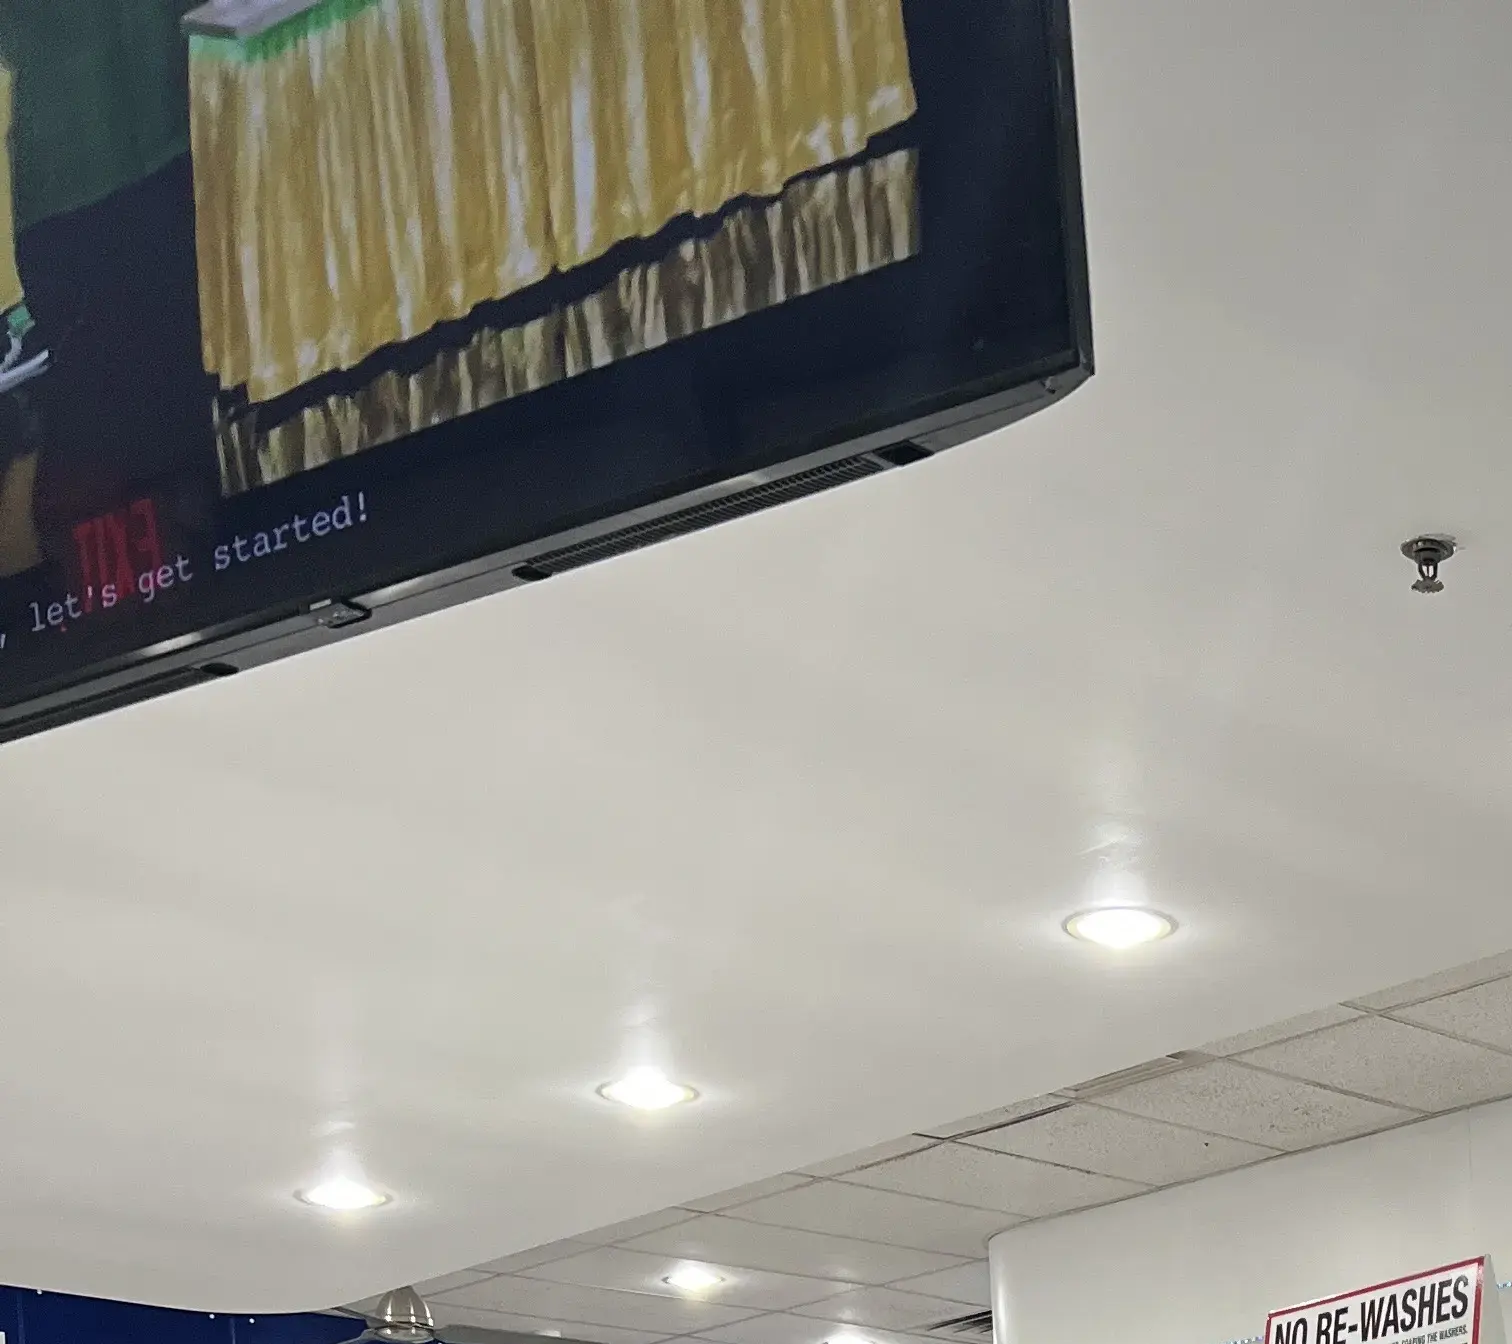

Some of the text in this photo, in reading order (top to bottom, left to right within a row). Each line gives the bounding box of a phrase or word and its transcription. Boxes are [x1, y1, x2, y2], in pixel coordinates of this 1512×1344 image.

[29, 491, 367, 632] let's get started!
[1427, 1334, 1437, 1343] THE
